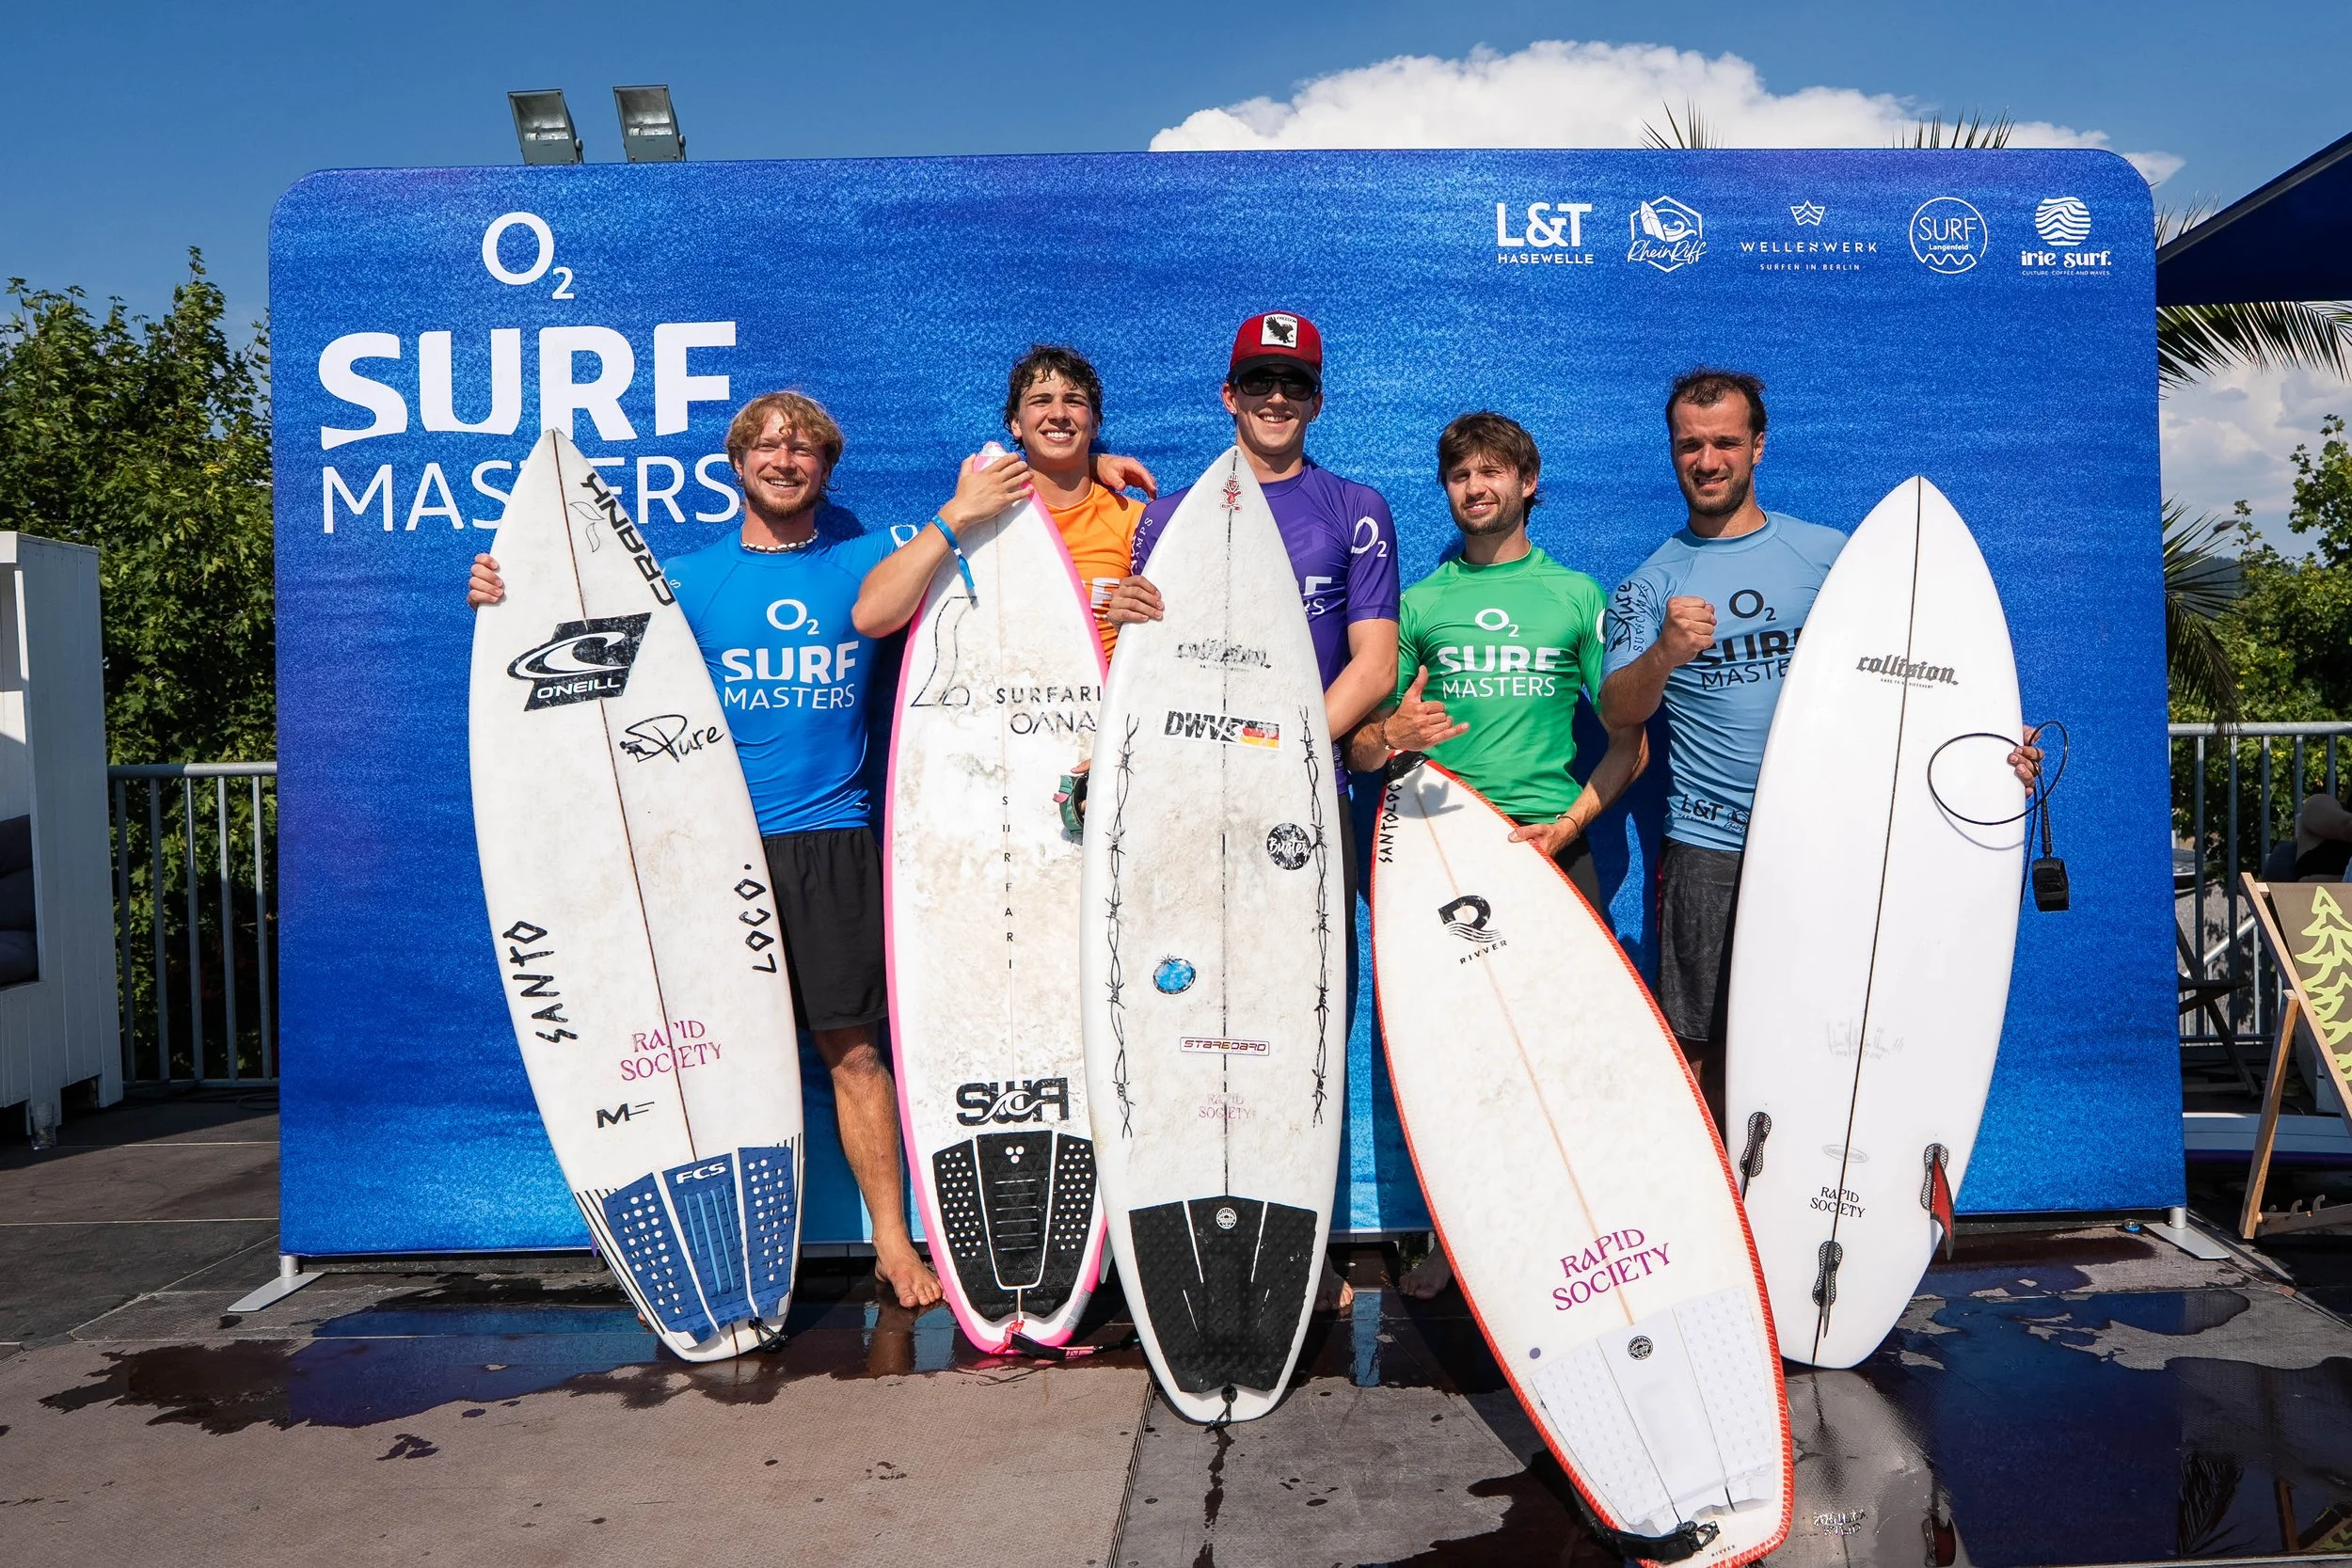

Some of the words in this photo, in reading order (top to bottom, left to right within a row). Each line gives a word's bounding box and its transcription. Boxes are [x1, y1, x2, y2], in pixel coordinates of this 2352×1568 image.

[1496, 201, 1593, 247] L&T
[1918, 216, 1978, 241] SURF
[1498, 253, 1595, 264] HASEWELLE
[1627, 239, 1708, 265] RheinRiff
[1740, 241, 1878, 253] WELLENWERK
[1929, 243, 1969, 252] Langenfeld
[2021, 250, 2057, 266] irie
[2063, 250, 2112, 268] surf.
[317, 320, 737, 451] SURF
[323, 453, 740, 534] MASRS
[721, 640, 859, 685] SURF
[1437, 644, 1562, 676] SURF
[1701, 657, 1791, 690] MASTE
[536, 676, 621, 699] O'NEILL
[724, 683, 856, 710] MASTERS
[995, 685, 1102, 705] SURFARI
[1441, 676, 1556, 700] MASTERS
[620, 713, 725, 764] Pure
[1680, 793, 1724, 821] L&T
[1459, 940, 1508, 965] RIVVER
[502, 920, 579, 1043] SANTO
[620, 1040, 722, 1082] SOCIETY
[675, 1162, 726, 1184] FCS
[1820, 1185, 1860, 1204] RAPID
[1809, 1196, 1867, 1220] SOCIETY
[1559, 1227, 1645, 1279] RAPID
[1551, 1243, 1671, 1311] SOCIETY
